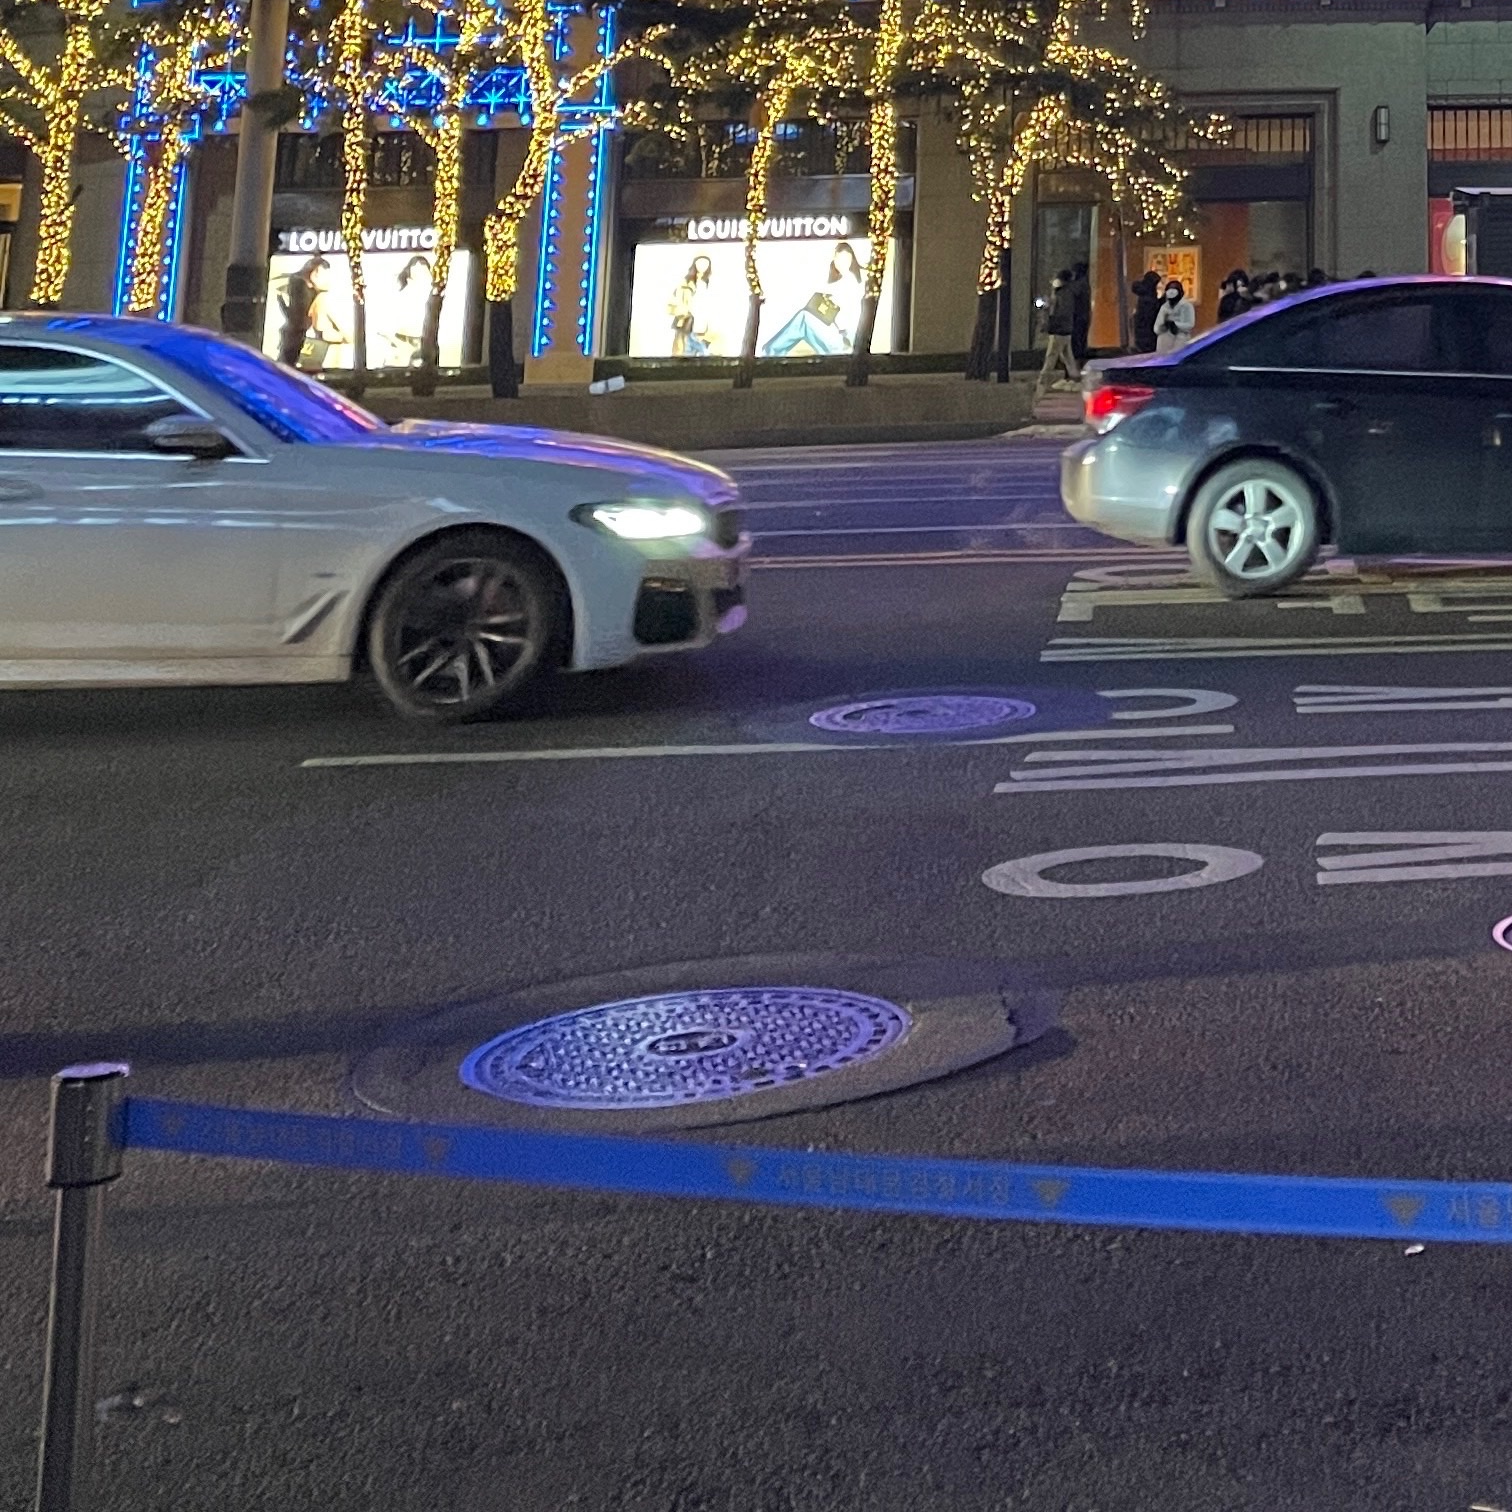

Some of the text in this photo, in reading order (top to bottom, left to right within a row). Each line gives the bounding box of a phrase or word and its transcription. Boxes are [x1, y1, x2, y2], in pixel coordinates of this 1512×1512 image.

[758, 215, 850, 238] VUITTON
[288, 227, 442, 252] LOUI VUITTO
